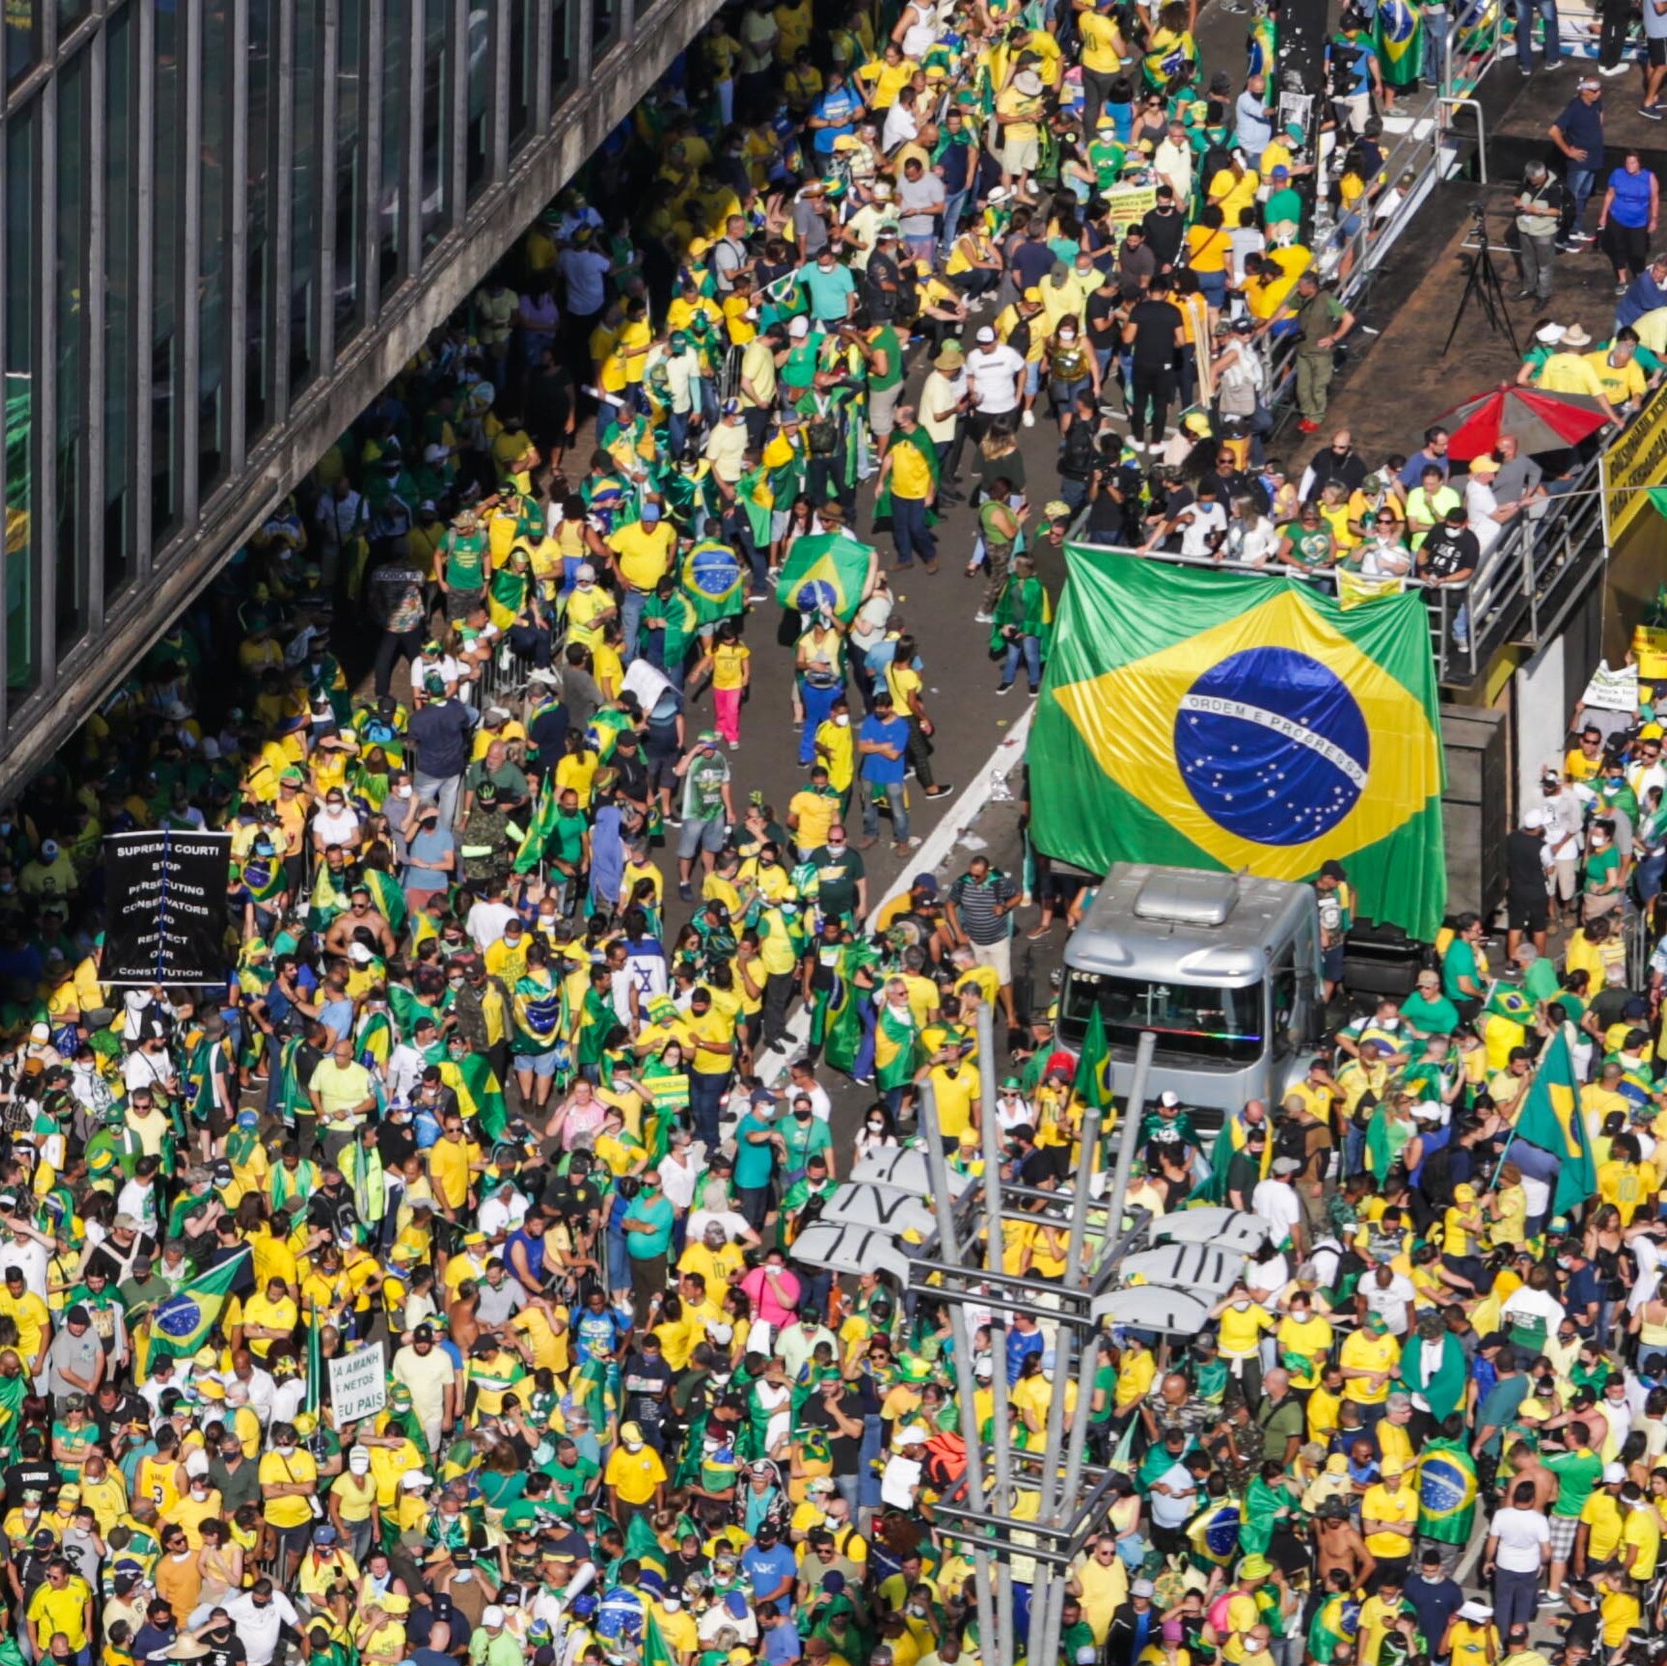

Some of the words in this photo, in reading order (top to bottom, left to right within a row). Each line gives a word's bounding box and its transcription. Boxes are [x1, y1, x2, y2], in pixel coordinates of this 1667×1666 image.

[1189, 697, 1246, 718] ORDEM
[1254, 711, 1263, 722] E
[1270, 717, 1363, 782] PROGRESSO
[174, 844, 219, 856] COURT!
[152, 861, 181, 872] STOP
[119, 967, 203, 977] CONSTTUTION
[713, 1262, 726, 1279] 10
[343, 1372, 374, 1392] NETOS
[153, 1485, 163, 1505] 3
